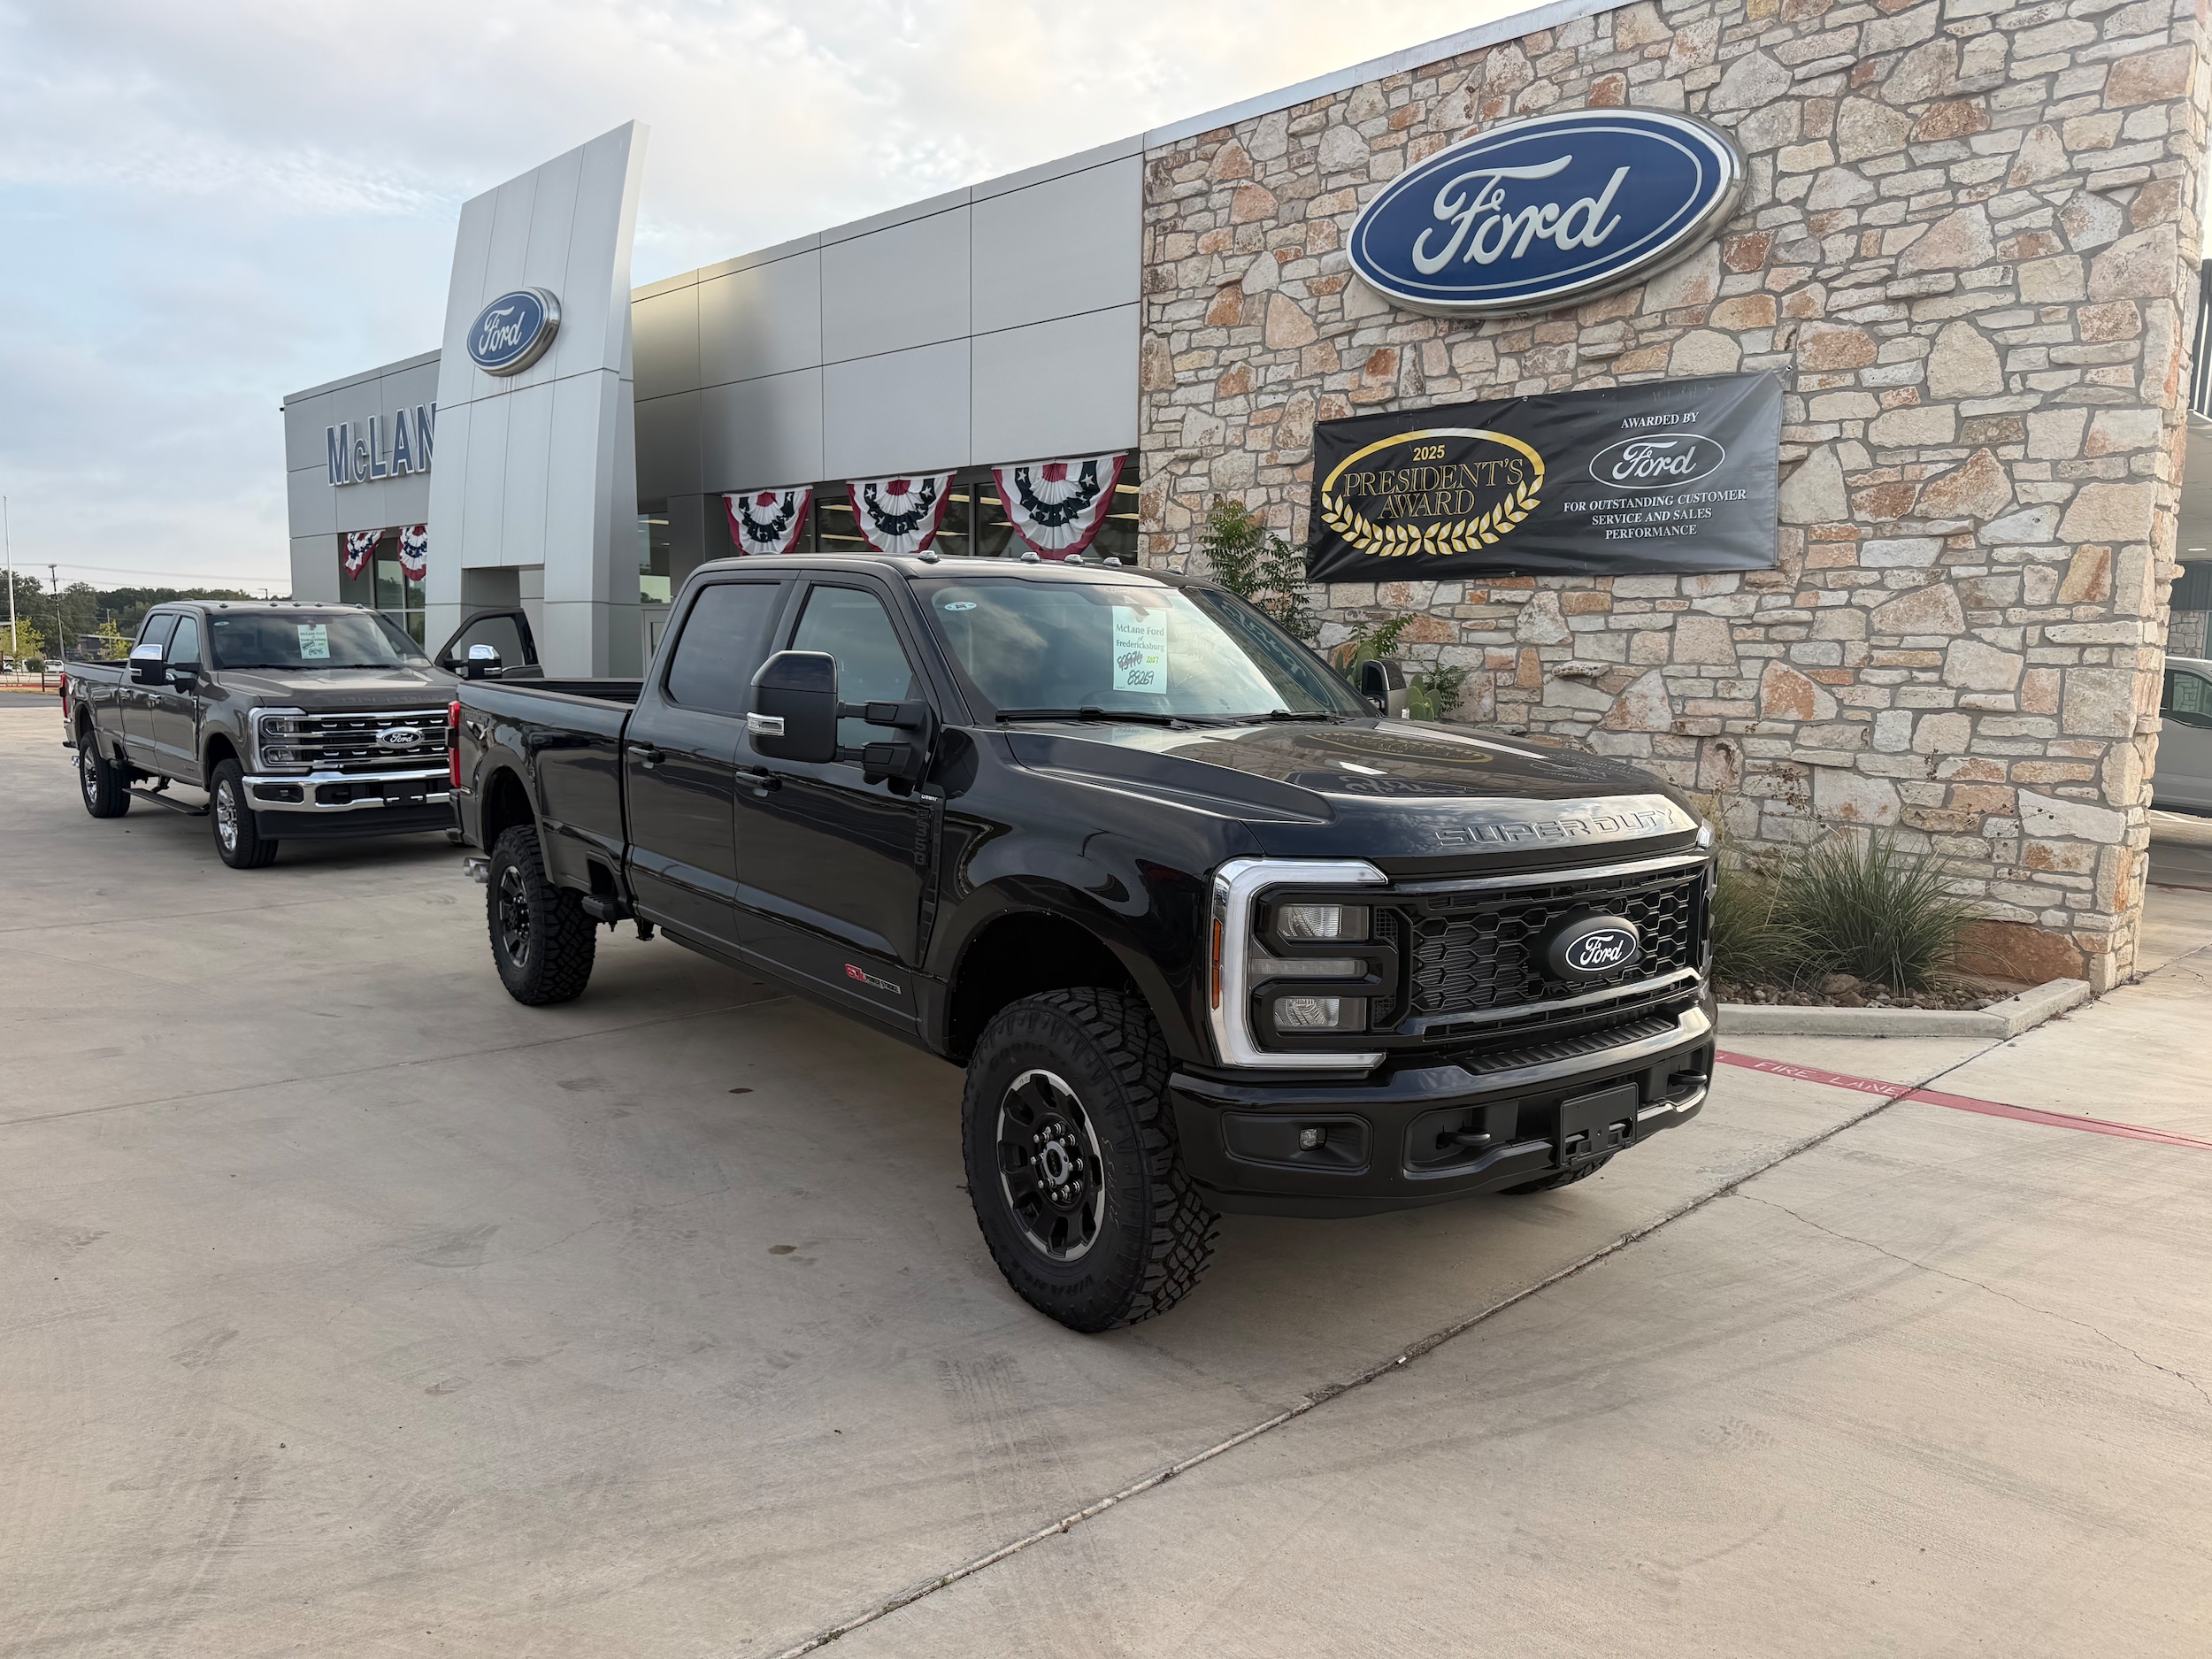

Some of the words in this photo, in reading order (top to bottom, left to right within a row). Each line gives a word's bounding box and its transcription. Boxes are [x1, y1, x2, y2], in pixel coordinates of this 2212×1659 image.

[1412, 155, 1631, 275] Ford
[479, 306, 525, 356] Ford
[1621, 414, 1679, 429] AWARDED
[1683, 412, 1699, 423] BY
[1412, 444, 1446, 462] 2025
[1612, 441, 1696, 480] Ford
[1342, 458, 1524, 497] PRESIDENT'S
[1377, 489, 1475, 519] AWARD
[1563, 502, 1586, 512] FOR
[1589, 495, 1674, 511] OUTSTANDING
[1678, 489, 1747, 505] CUSTOMER
[1592, 513, 1642, 526] SERVICE
[1645, 511, 1671, 522] AND
[1673, 508, 1712, 520] SALES
[1605, 524, 1697, 540] PERFORMANCE
[1116, 624, 1145, 634] McLane
[1147, 626, 1164, 636] Ford
[1117, 639, 1164, 652] Fredericksburg
[389, 733, 414, 743] Ford
[1434, 818, 1592, 847] SUPER
[1593, 808, 1673, 835] DUTY
[1579, 934, 1625, 966] Ford
[1754, 1062, 1817, 1078] FIRE
[1829, 1077, 1911, 1098] LANE
